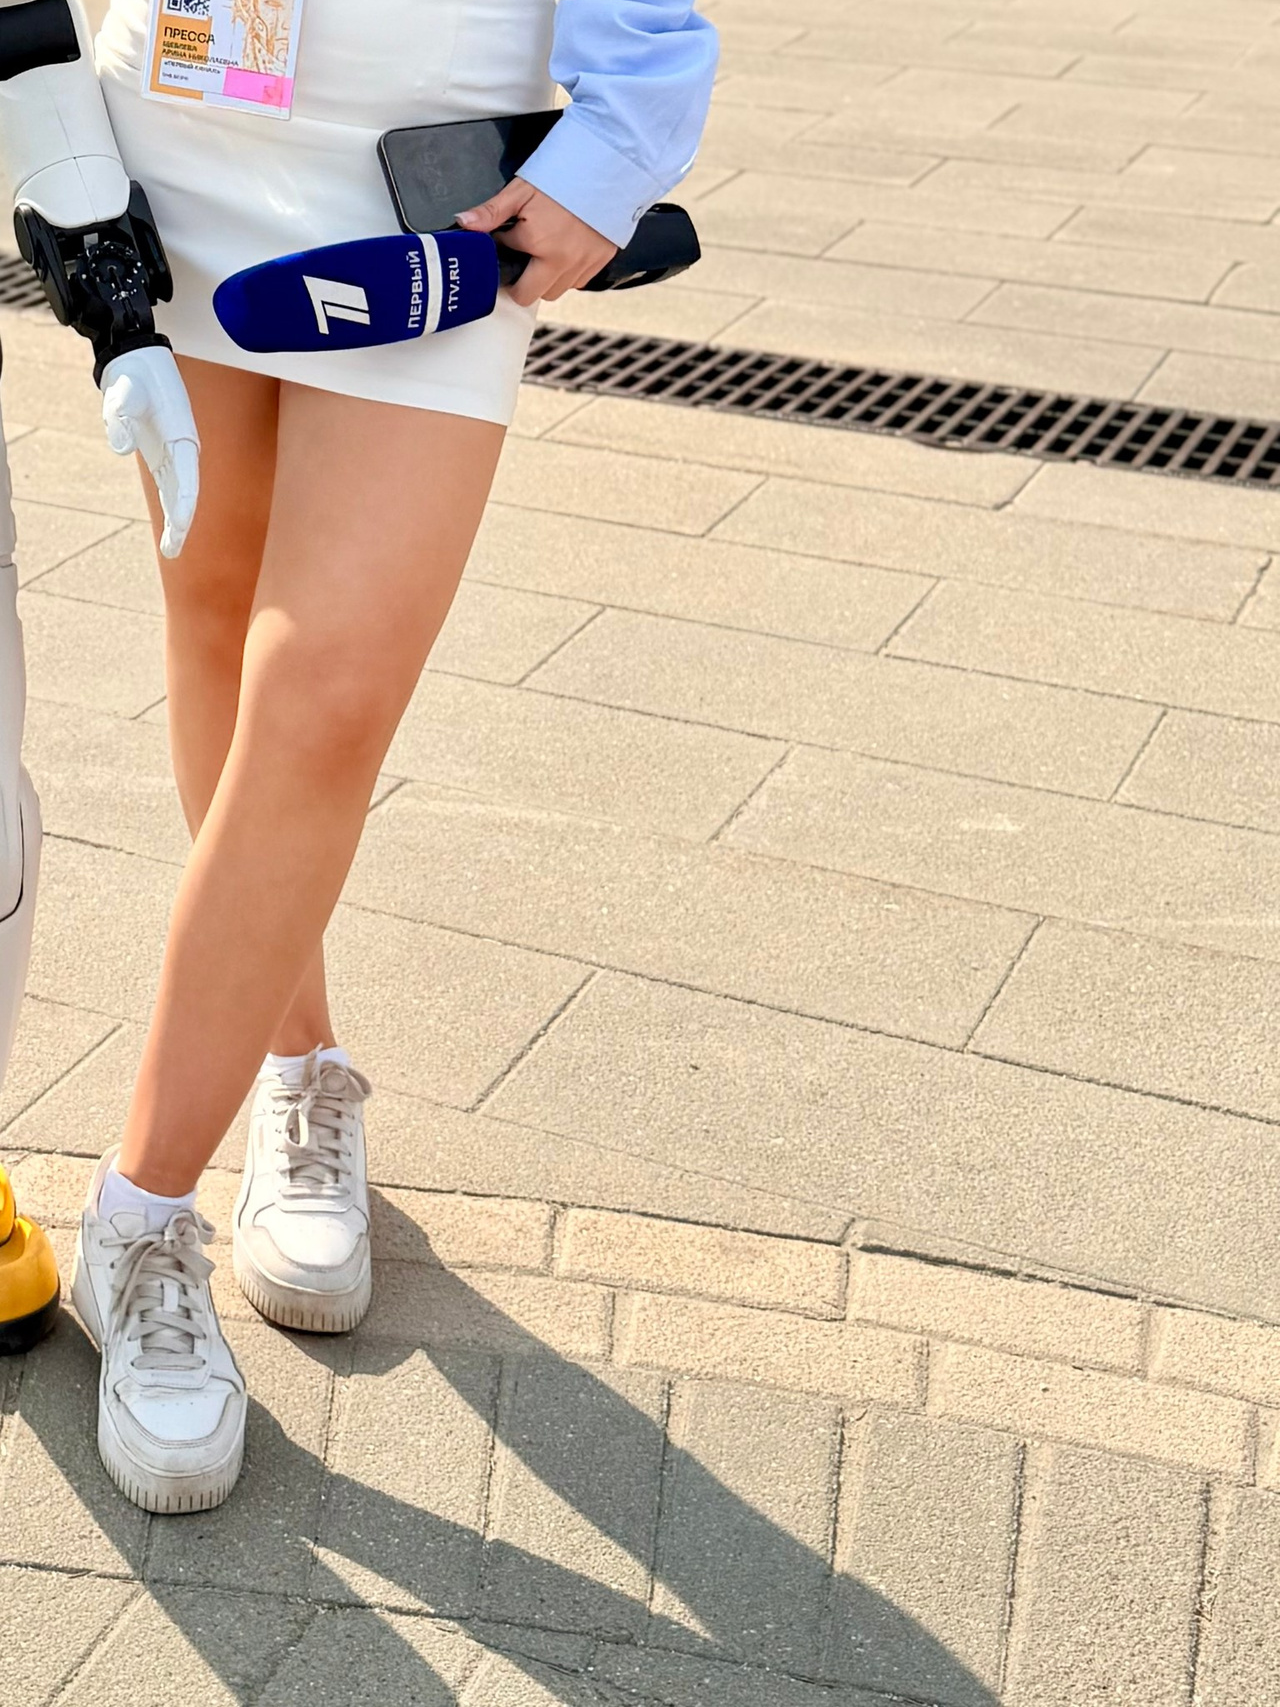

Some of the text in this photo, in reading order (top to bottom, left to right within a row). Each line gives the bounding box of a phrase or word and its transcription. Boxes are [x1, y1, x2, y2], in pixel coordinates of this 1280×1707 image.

[164, 26, 216, 45] ПРЕССА
[406, 250, 423, 329] ПЕРВЫЙ
[447, 257, 461, 312] 1TV.RU
